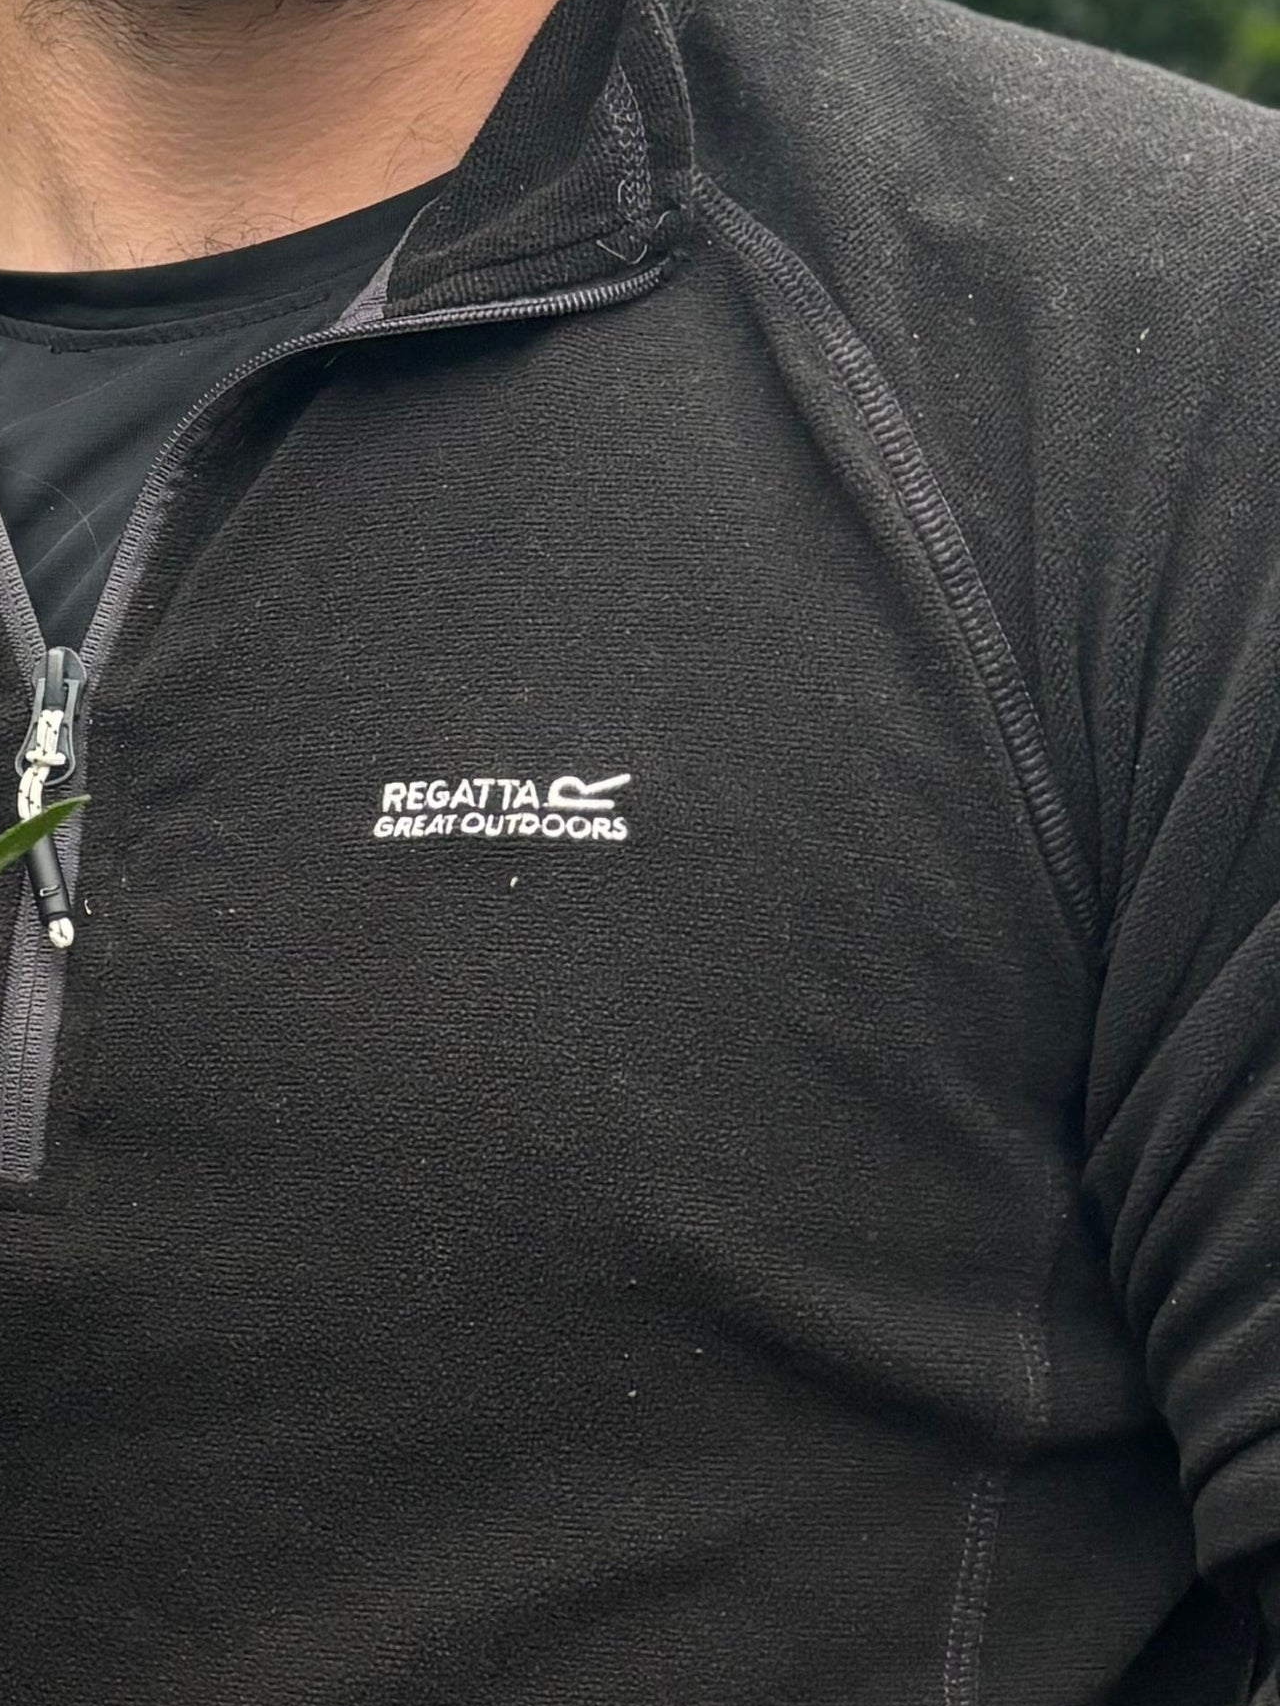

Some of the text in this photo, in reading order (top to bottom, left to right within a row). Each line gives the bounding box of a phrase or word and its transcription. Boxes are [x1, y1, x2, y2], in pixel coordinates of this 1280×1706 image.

[382, 778, 540, 812] REGATTA
[373, 812, 628, 840] GREAT OUTDOORS
